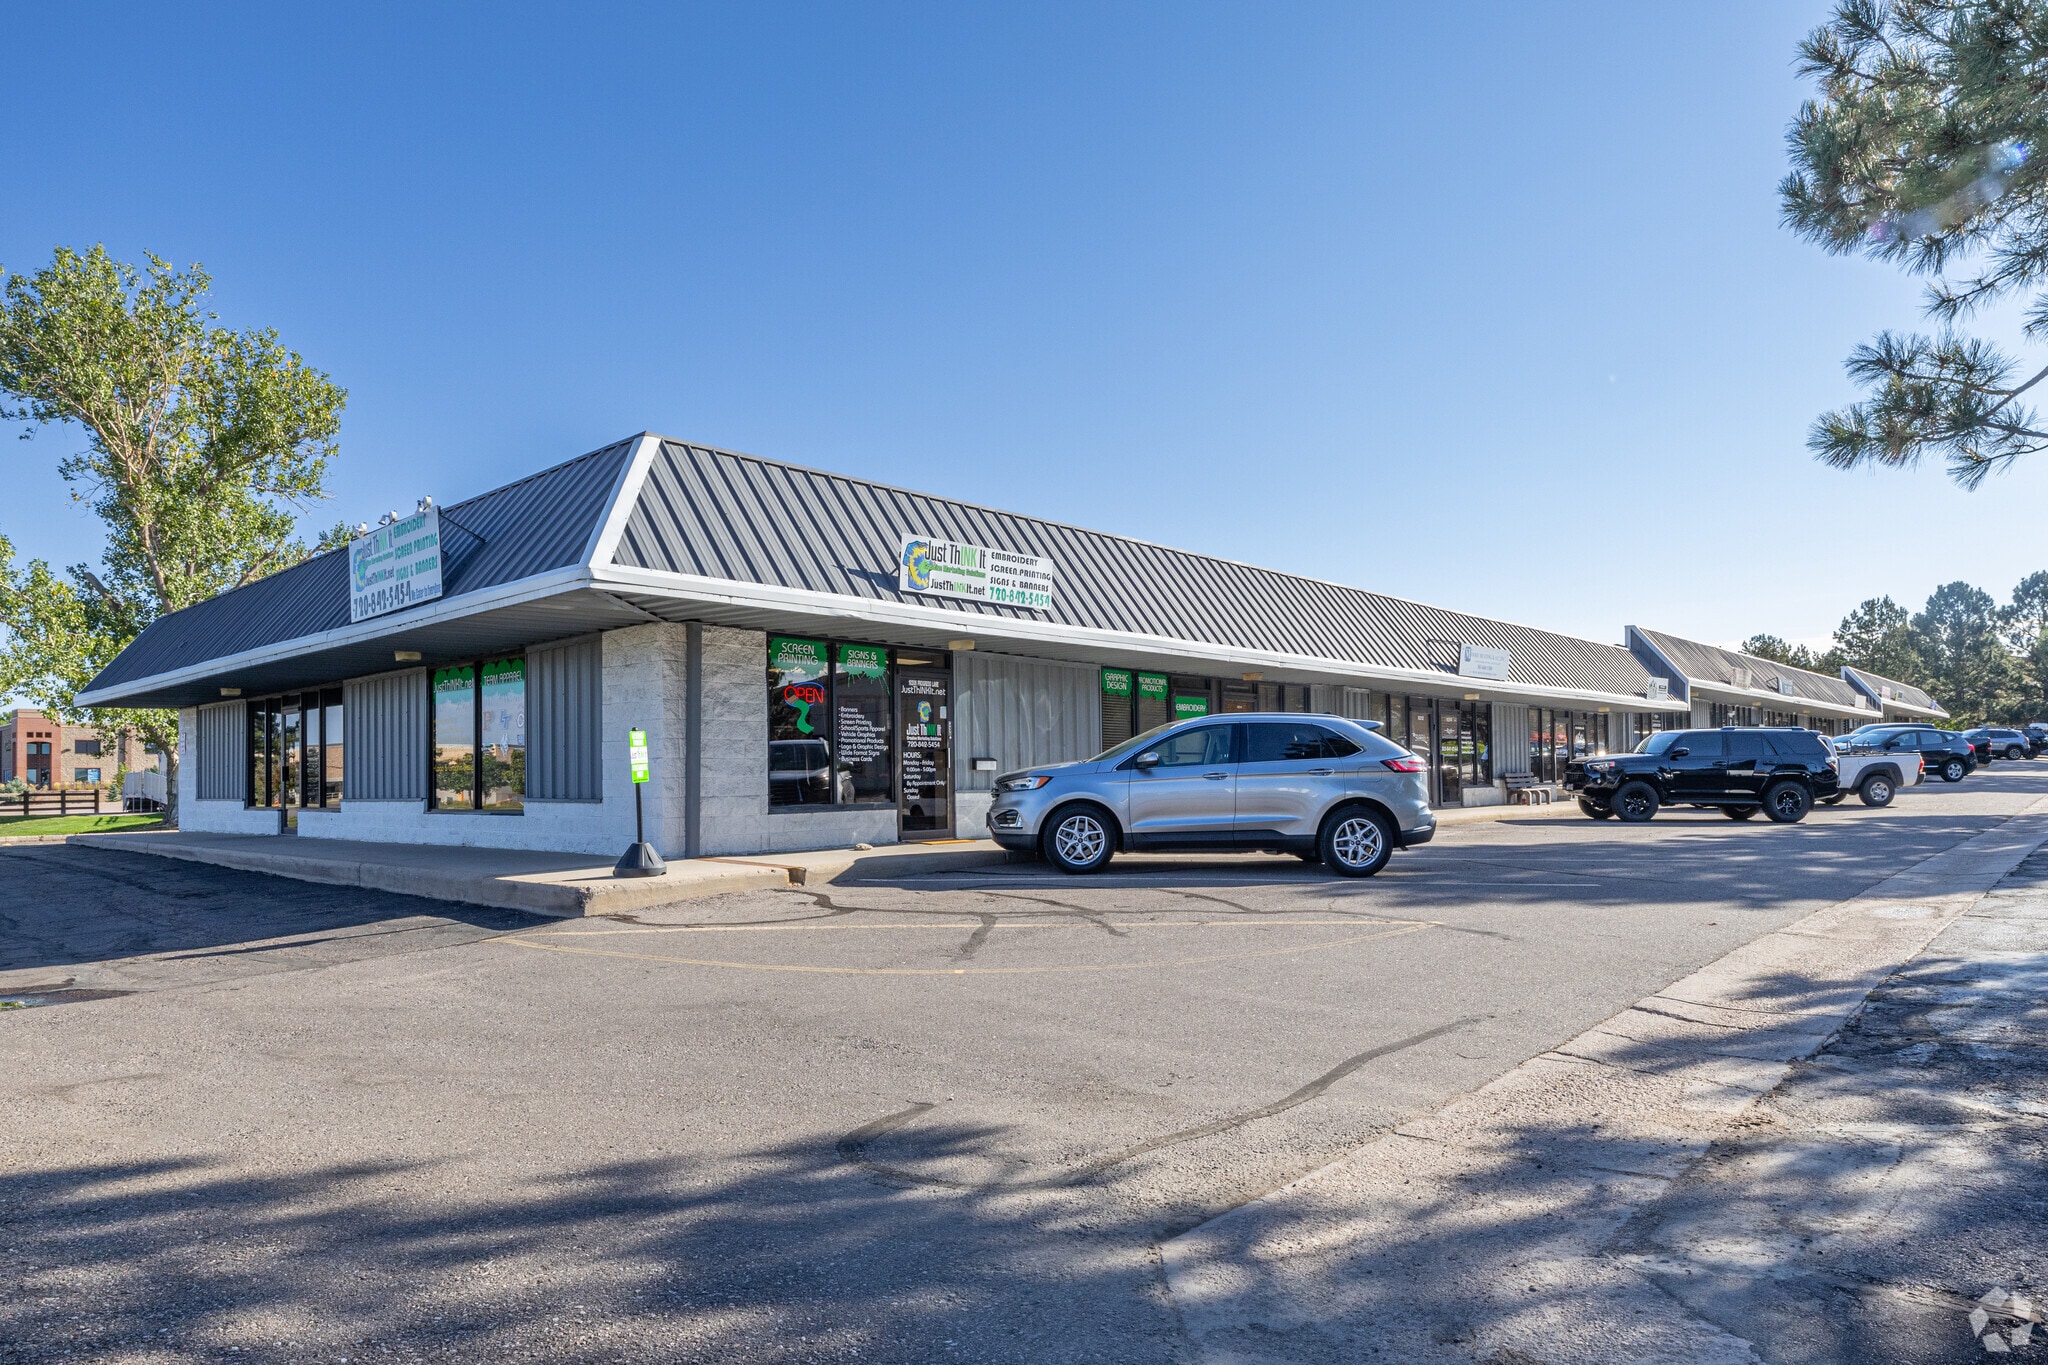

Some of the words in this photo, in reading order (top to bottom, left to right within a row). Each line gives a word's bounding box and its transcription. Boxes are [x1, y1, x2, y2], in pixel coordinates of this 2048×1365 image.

[393, 515, 426, 539] EMBROIDERY
[362, 538, 373, 559] Just
[394, 541, 413, 561] SCREEN
[413, 532, 438, 552] PRINTING
[924, 540, 947, 563] Just
[949, 544, 978, 568] ThINK
[979, 549, 986, 569] It
[991, 551, 1039, 567] EMBROIDERY
[395, 565, 409, 582] SIGNS
[415, 555, 438, 575] BANNERS
[990, 564, 1018, 576] SCREEN
[1019, 569, 1051, 581] PRINTING
[930, 578, 986, 596] JustThINKIt.net
[990, 576, 1010, 586] SIGNS
[1012, 579, 1016, 588] &
[1019, 581, 1049, 592] BANNERS
[353, 580, 412, 618] 720-842-5454
[989, 586, 1051, 607] 720-842-5454
[781, 642, 815, 655] SCREEN
[847, 650, 870, 660] SIGNS
[871, 651, 877, 661] &
[777, 652, 819, 666] PRINTING
[846, 659, 879, 670] BANNERS
[483, 674, 498, 687] TEAM
[499, 671, 523, 684] APPAREL
[1104, 672, 1129, 683] GRAPHIC
[1106, 681, 1127, 690] DESIGN
[783, 685, 825, 704] OPEN
[1141, 685, 1163, 693] PRODUCTS
[1175, 703, 1207, 712] EMBROIDERY
[906, 722, 920, 736] Just
[902, 751, 922, 759] HOURS:
